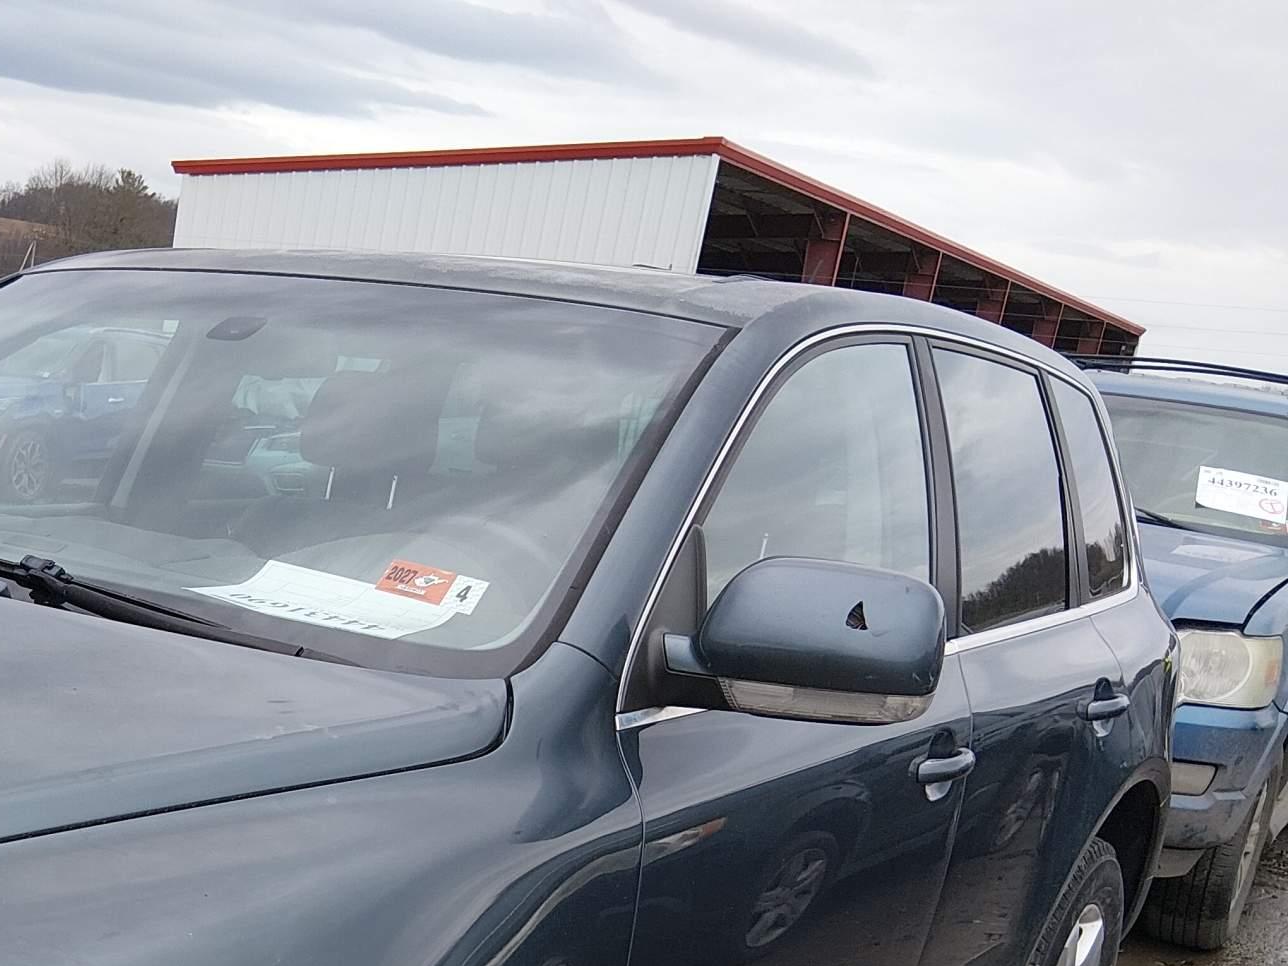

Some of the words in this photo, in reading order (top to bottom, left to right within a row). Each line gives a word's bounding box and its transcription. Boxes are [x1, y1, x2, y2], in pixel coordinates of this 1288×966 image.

[1207, 477, 1278, 497] 44397236
[385, 565, 419, 585] 2027
[455, 585, 473, 603] 4
[229, 592, 386, 631] 44431690
